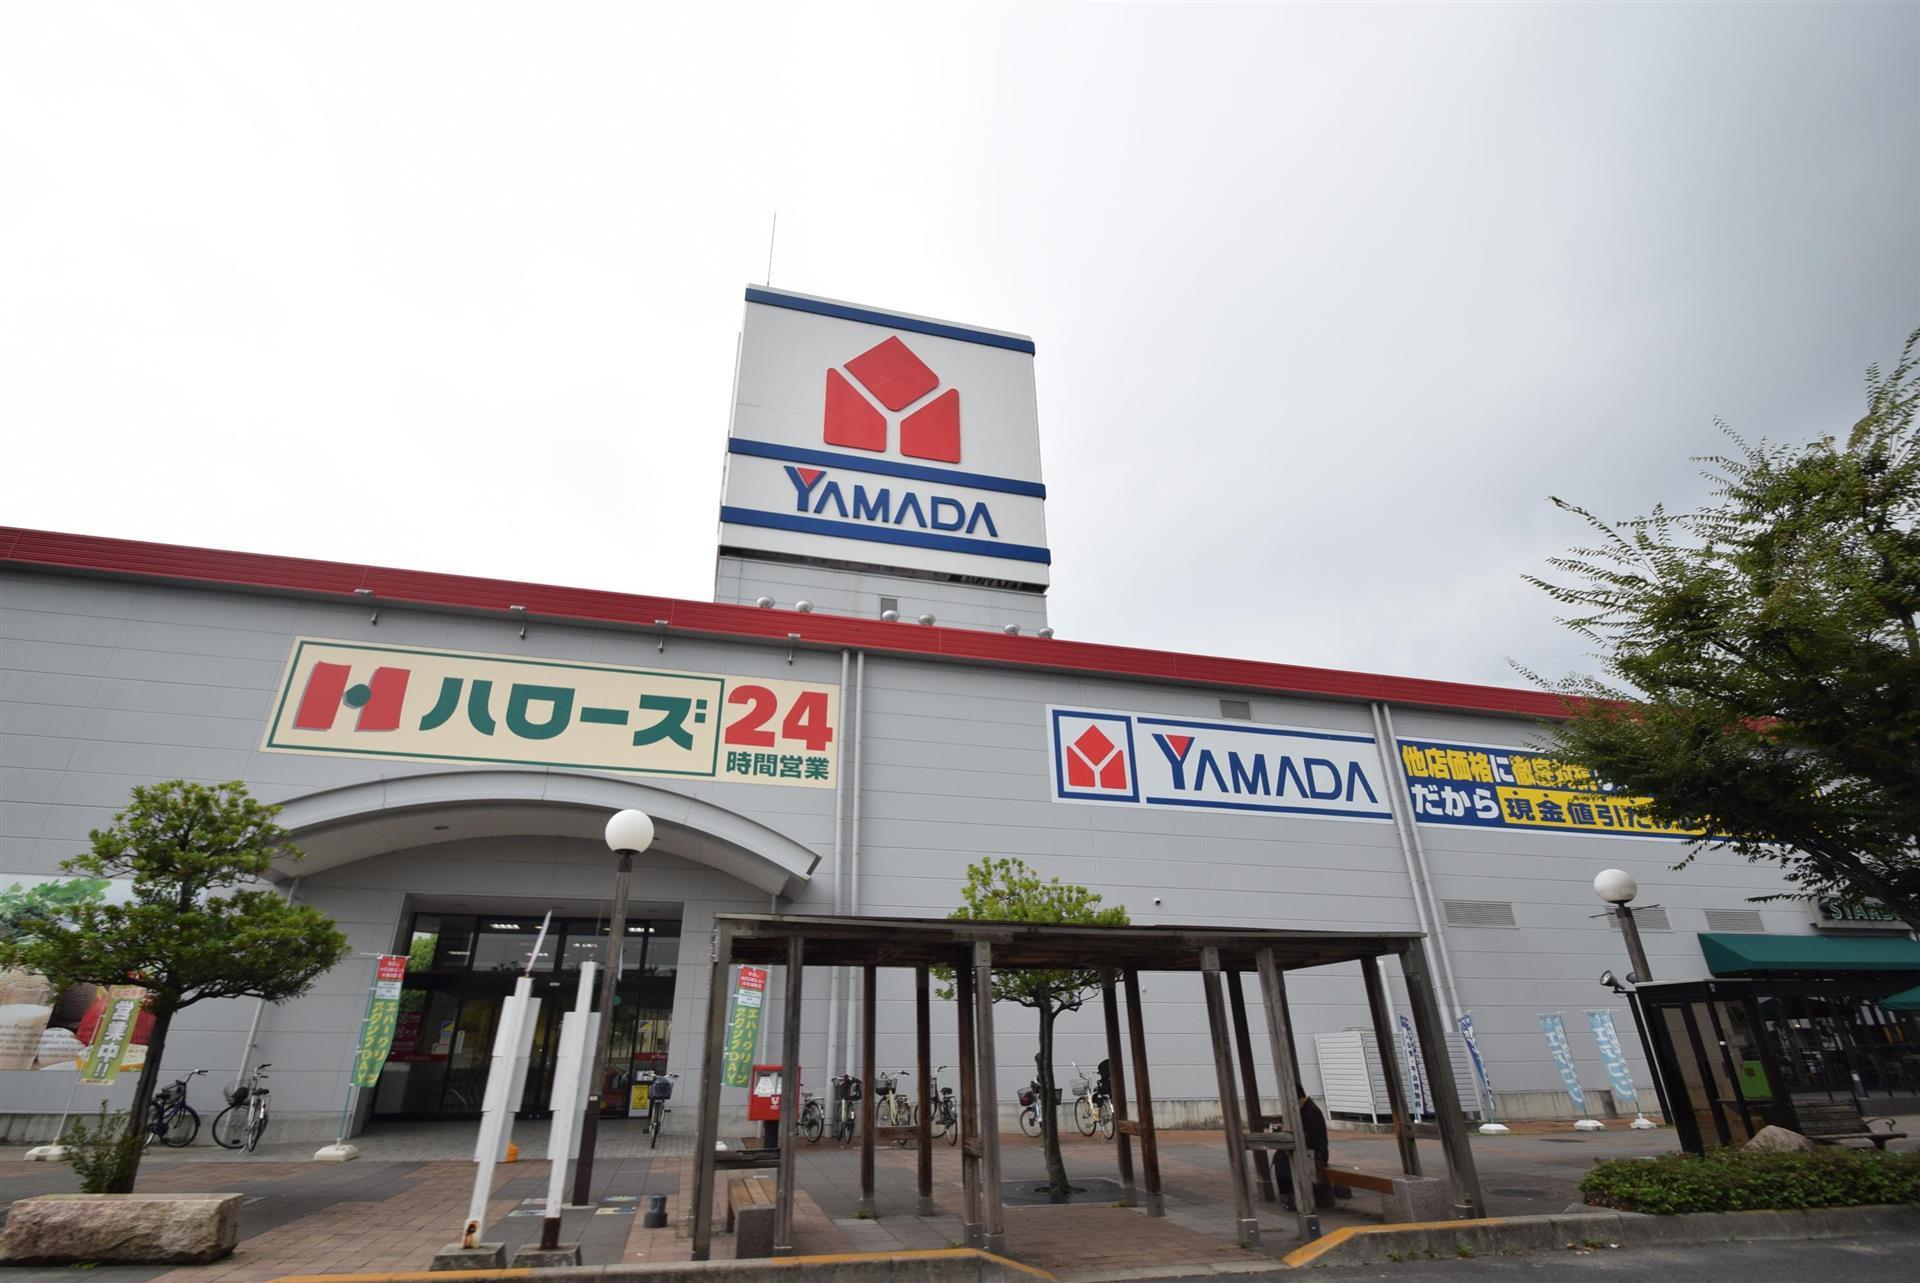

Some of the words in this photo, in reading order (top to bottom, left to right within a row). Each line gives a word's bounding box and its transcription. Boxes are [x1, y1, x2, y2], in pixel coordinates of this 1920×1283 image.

[783, 465, 998, 537] YAMADA
[419, 676, 706, 751] ハローズ
[724, 684, 833, 752] 24
[726, 750, 830, 781] 時間営業
[1151, 733, 1379, 804] YAMADA
